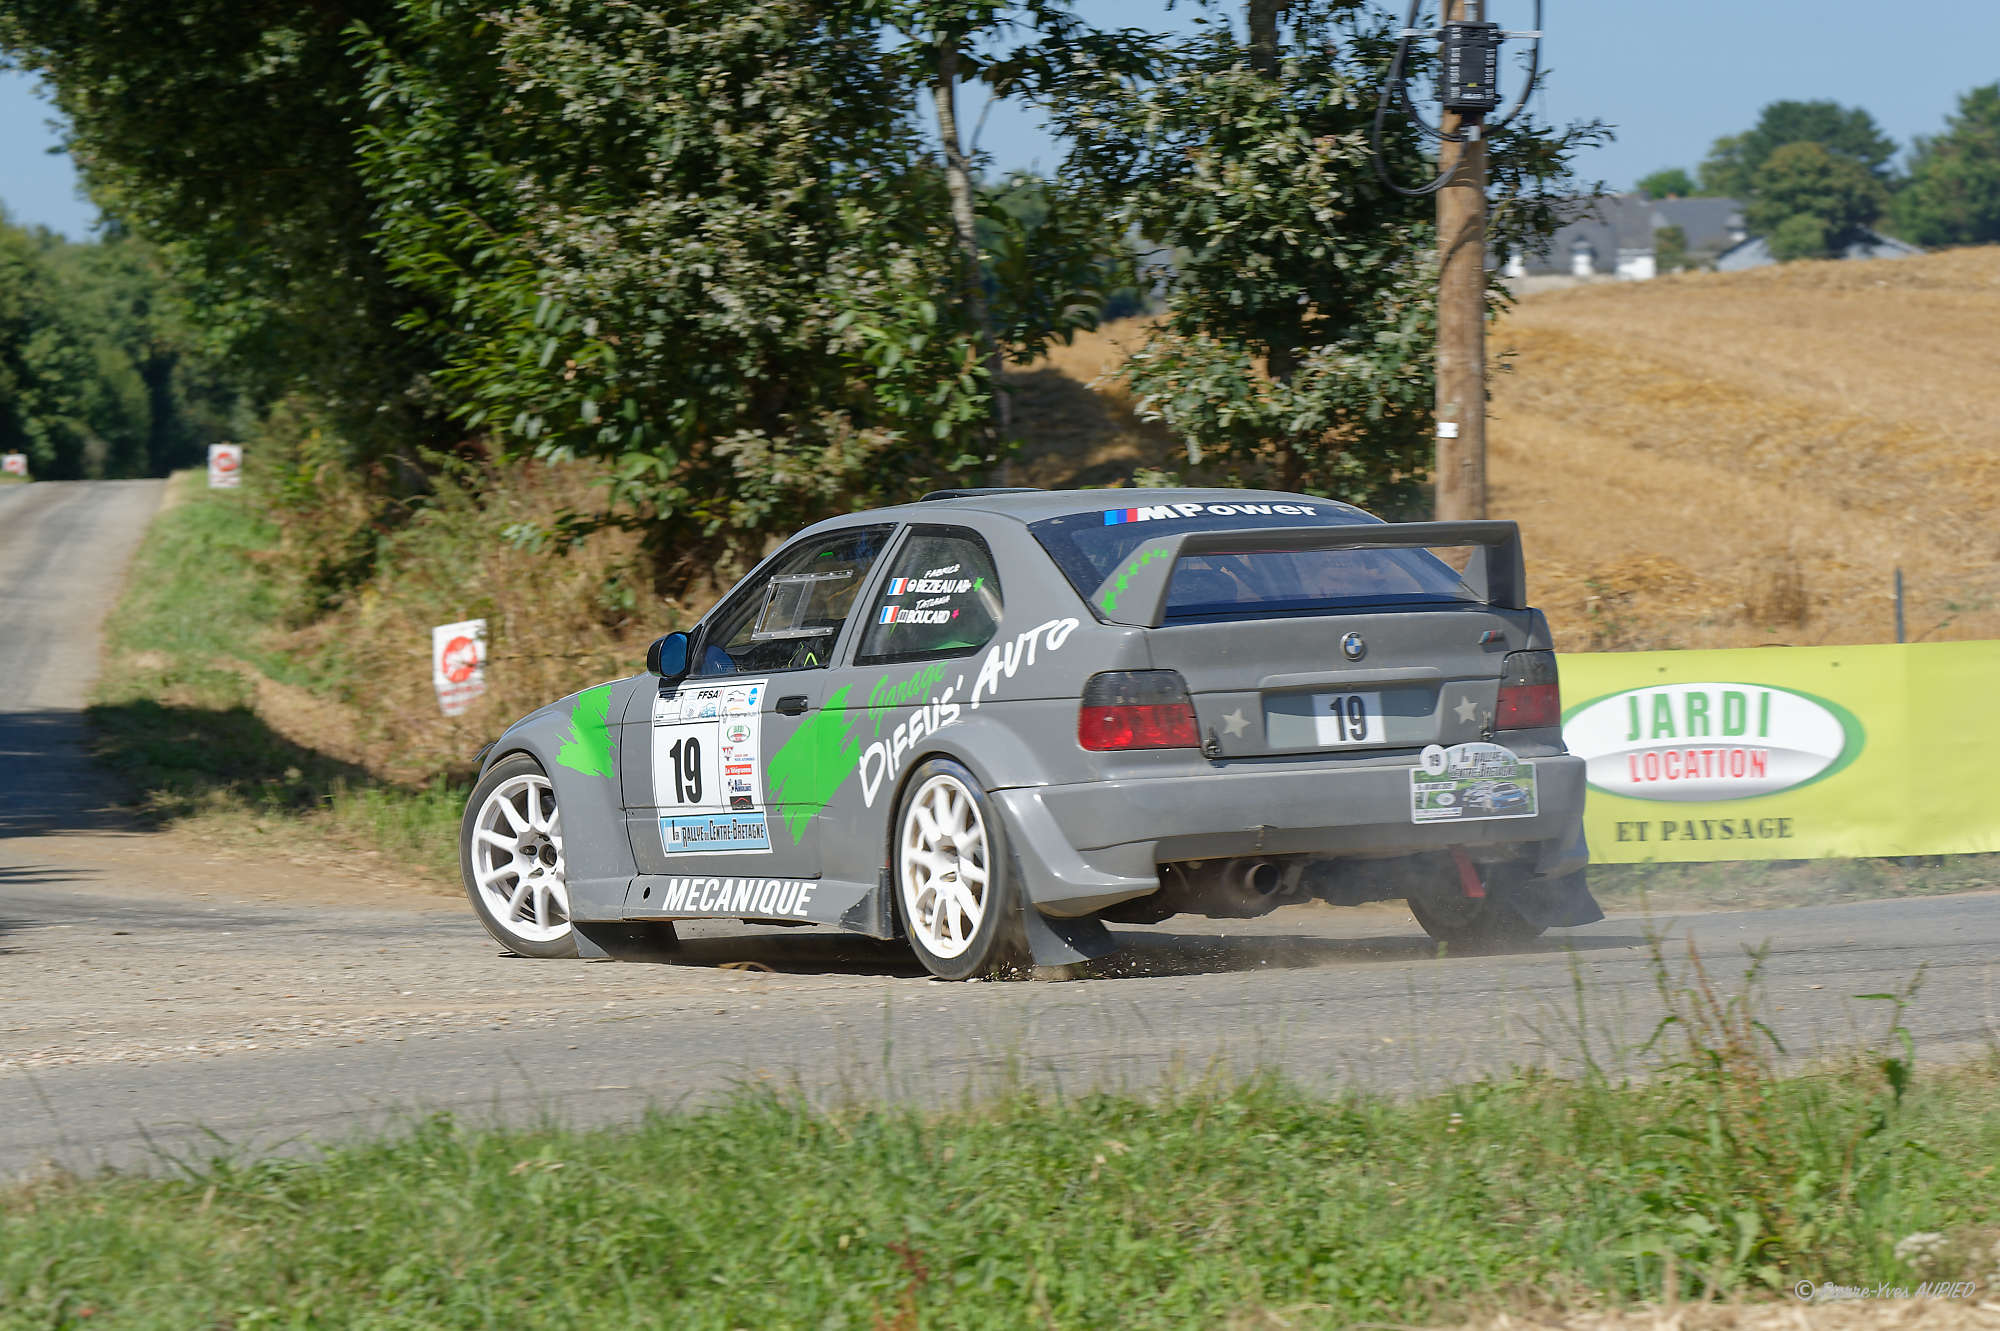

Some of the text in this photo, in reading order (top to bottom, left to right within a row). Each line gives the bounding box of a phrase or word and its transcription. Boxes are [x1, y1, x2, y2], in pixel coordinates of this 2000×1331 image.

[970, 617, 1080, 710] AUTO
[868, 661, 949, 737] Garage
[1329, 695, 1368, 742] 19
[1625, 690, 1771, 742] JARDI
[670, 737, 703, 804] 19
[1628, 749, 1768, 783] LOCATION
[682, 825, 704, 848] RALLYE
[1615, 817, 1795, 842] ET PAYSAGE
[662, 878, 817, 917] MECANIQUE
